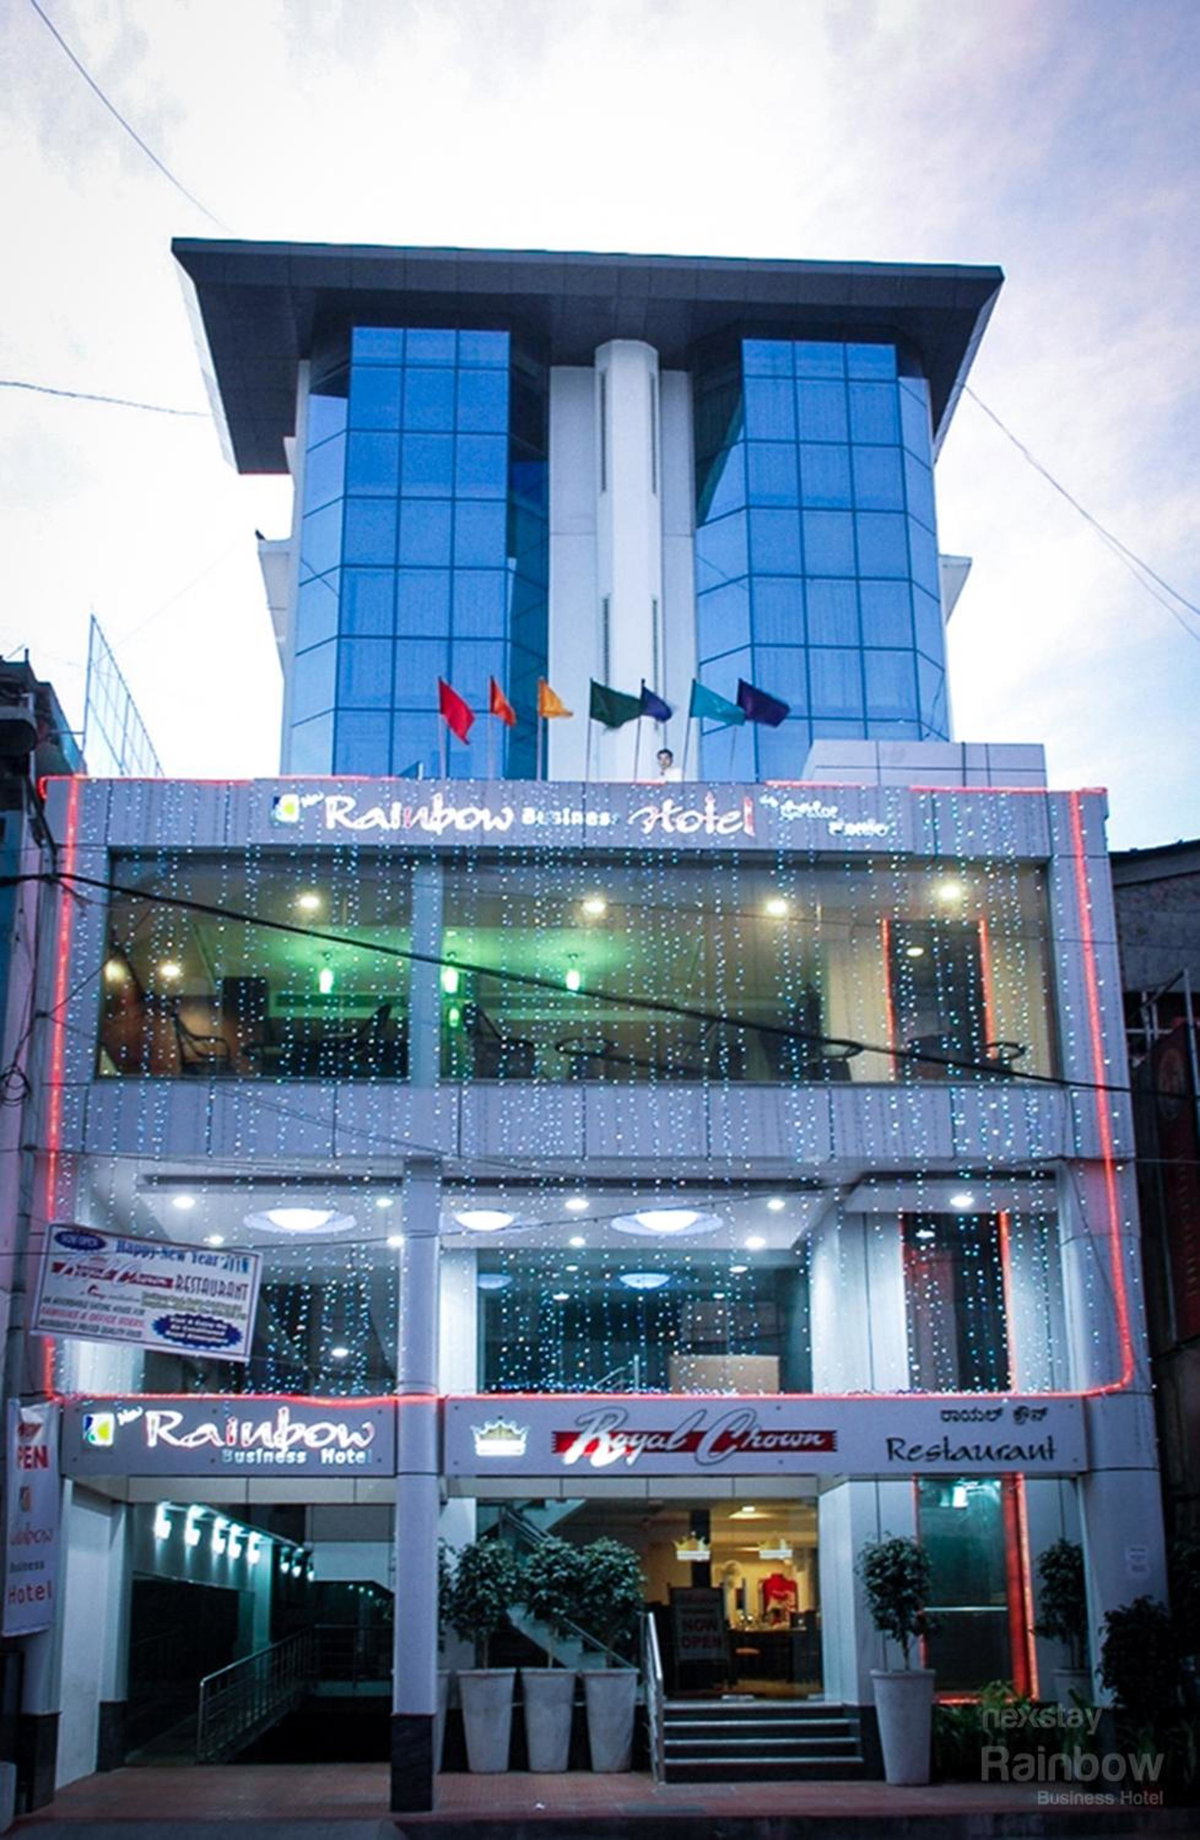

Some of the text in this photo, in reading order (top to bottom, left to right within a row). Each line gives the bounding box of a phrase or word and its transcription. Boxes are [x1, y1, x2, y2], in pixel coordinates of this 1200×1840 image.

[325, 793, 514, 835] Rainbow
[628, 792, 755, 836] Hotel
[175, 1274, 248, 1301] RESTAURANT
[145, 1406, 376, 1450] Rainbow
[562, 1406, 826, 1468] Royal Crown
[221, 1448, 373, 1465] Business Hotel
[886, 1435, 1057, 1462] Restaurant
[8, 1579, 53, 1606] Hotel
